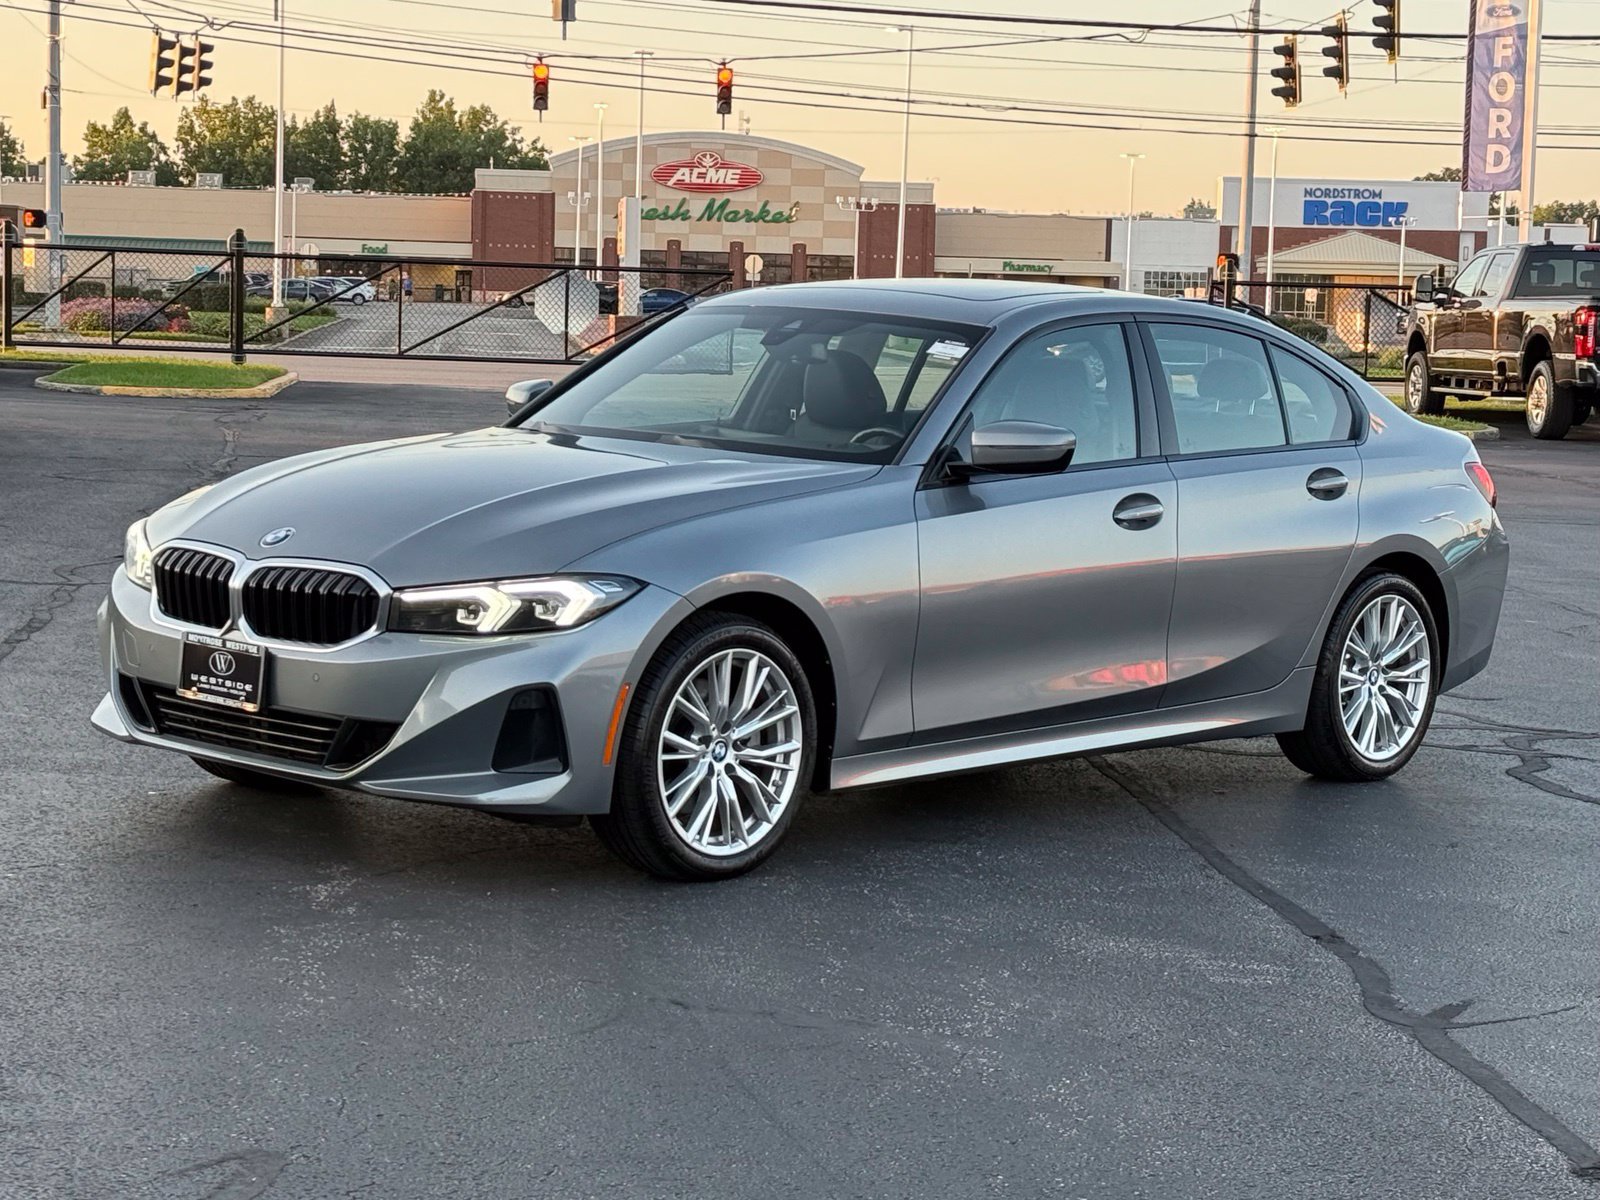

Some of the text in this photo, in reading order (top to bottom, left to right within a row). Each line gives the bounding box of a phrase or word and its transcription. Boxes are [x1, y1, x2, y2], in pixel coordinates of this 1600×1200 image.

[1485, 36, 1516, 174] FORD
[667, 168, 742, 186] ACME
[1304, 187, 1383, 199] NORDSTROM
[614, 196, 800, 224] esh Market
[361, 243, 388, 254] Food
[1002, 261, 1054, 274] Pharmacy
[190, 673, 253, 692] WESTSIDE
